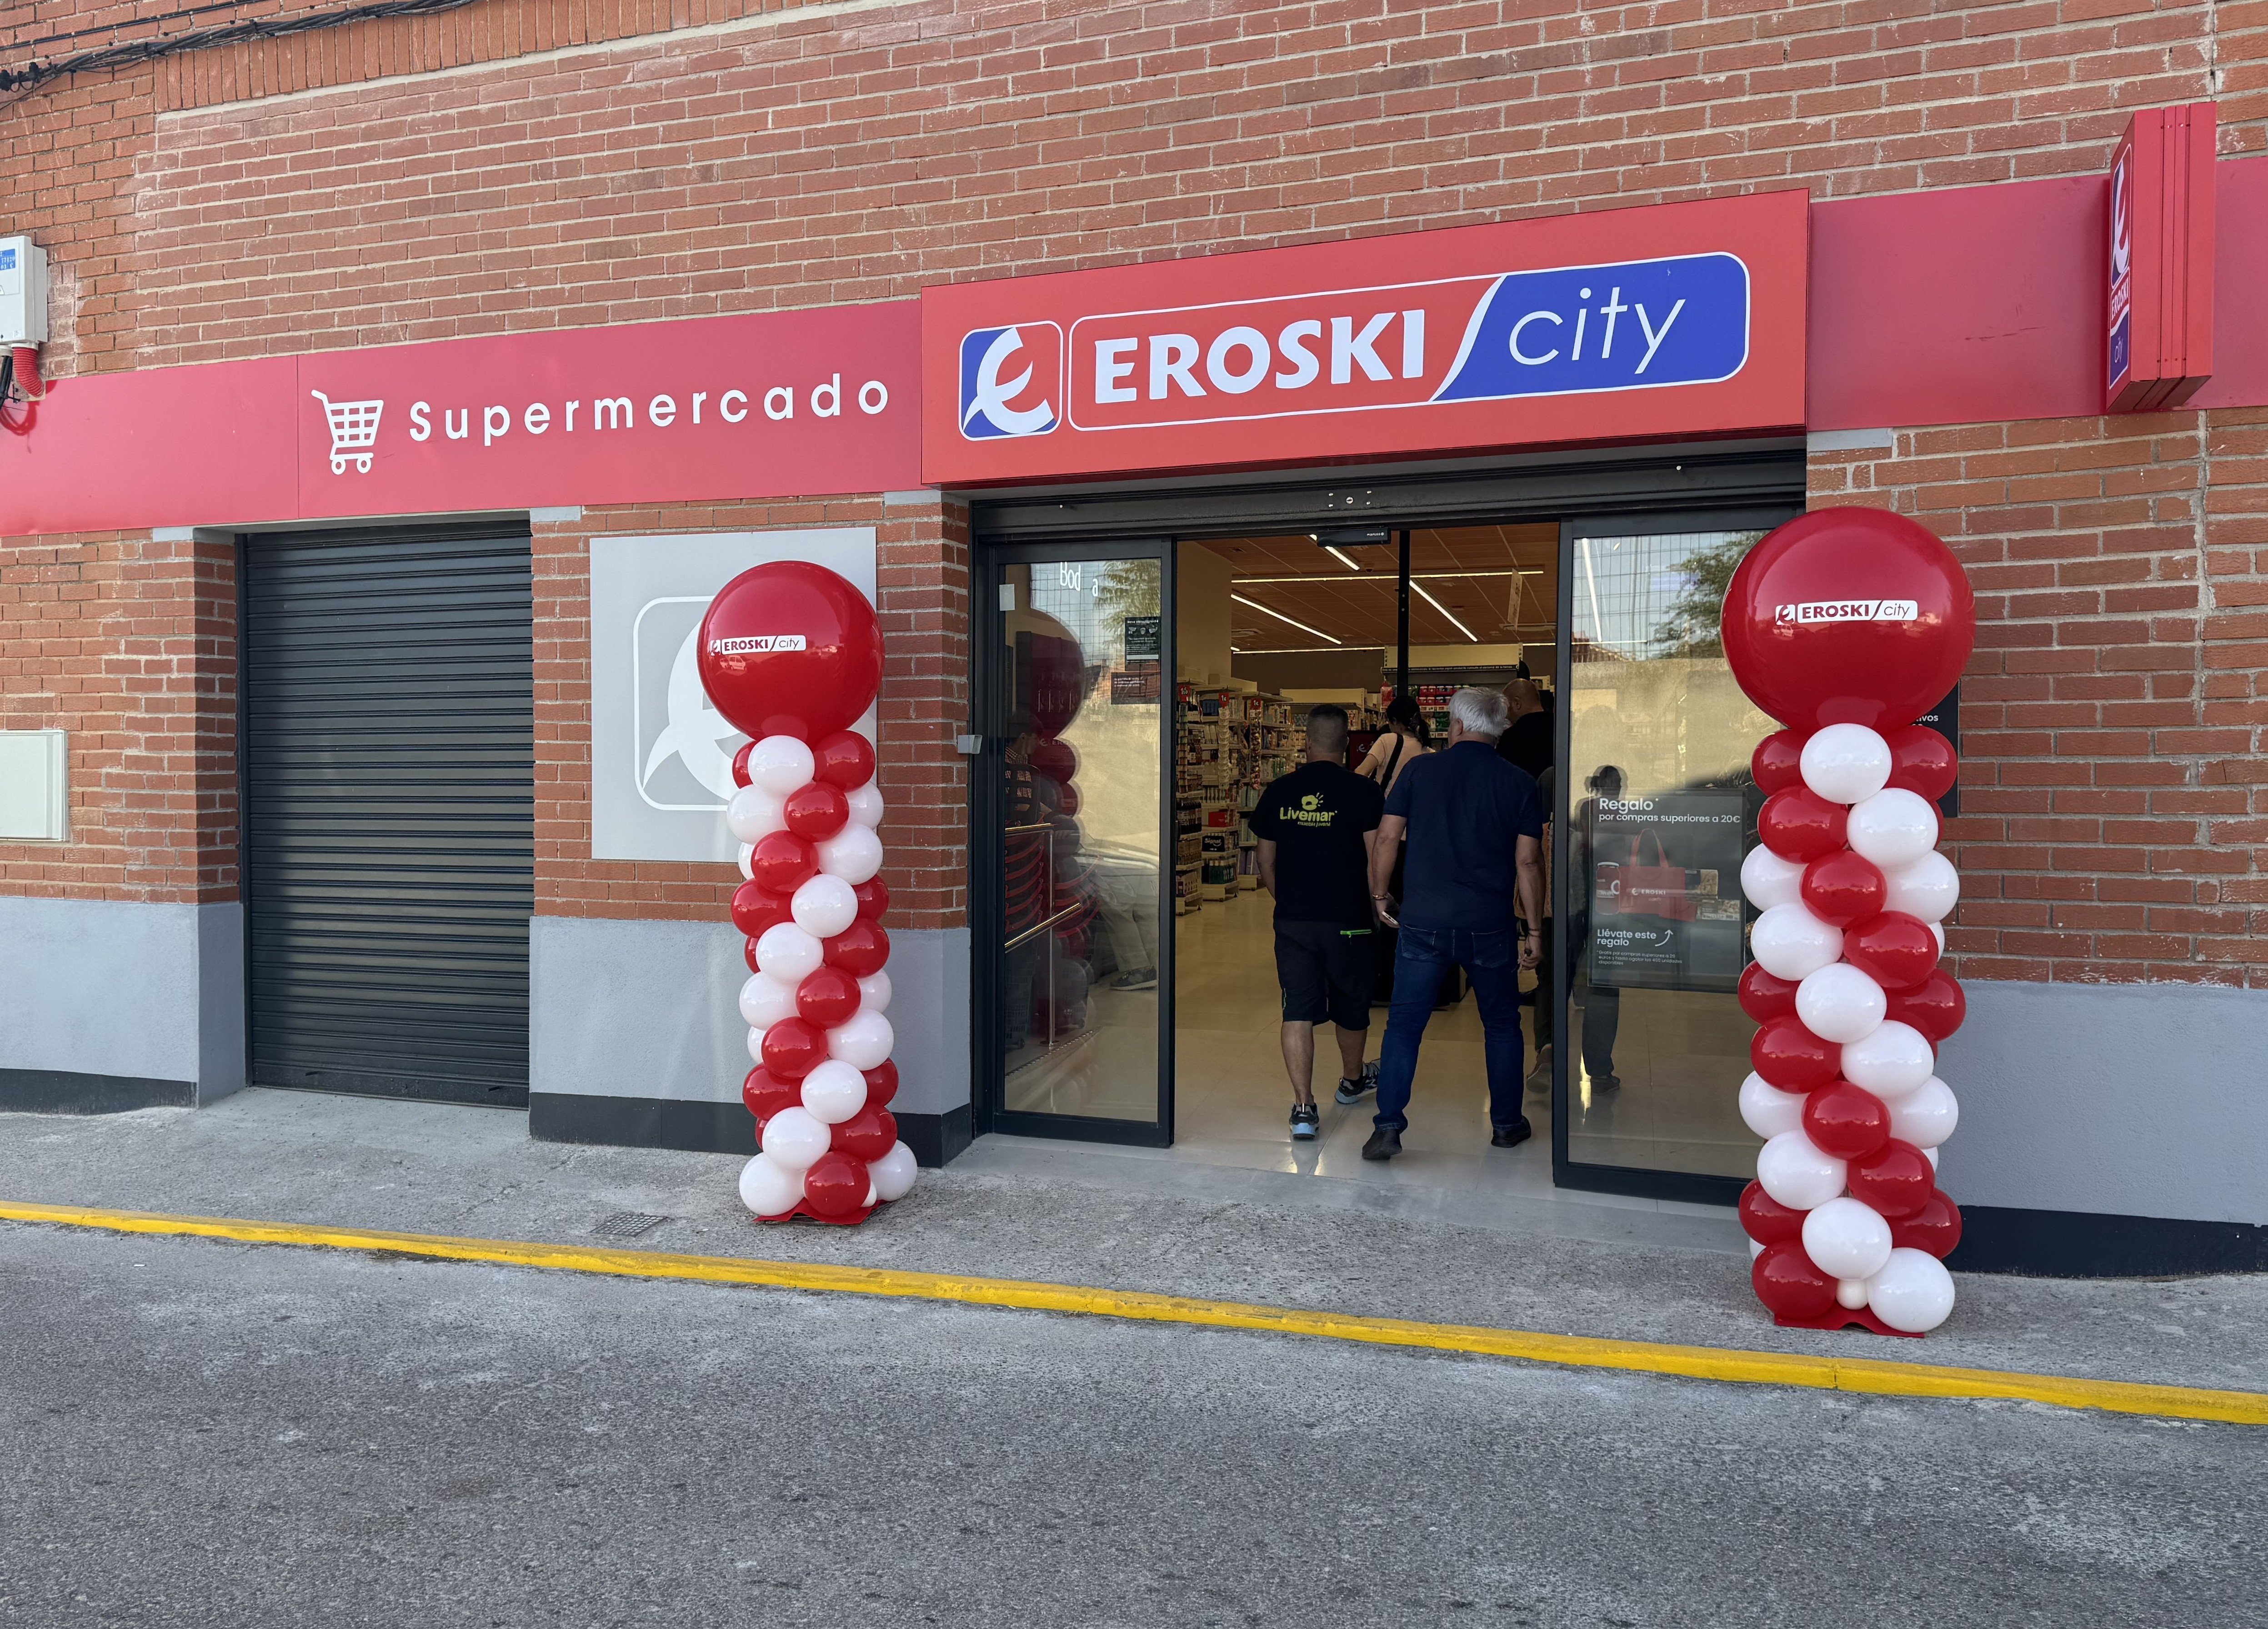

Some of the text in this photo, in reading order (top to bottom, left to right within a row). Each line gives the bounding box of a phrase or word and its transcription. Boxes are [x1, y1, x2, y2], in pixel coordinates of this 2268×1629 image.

[2112, 276, 2129, 321] EROSKI
[1094, 308, 1425, 404] EROSKI
[1509, 286, 1686, 375] city
[409, 372, 888, 447] Supermercado
[1802, 604, 1869, 619] EROSKI
[1883, 603, 1910, 619] city
[724, 637, 799, 652] EROSKI city
[1280, 807, 1335, 822] Livemar
[1599, 814, 1615, 822] por
[1616, 814, 1658, 823] compras
[1660, 814, 1710, 824] superiores
[1597, 929, 1657, 939] Llévate este
[1597, 937, 1629, 947] regalo
